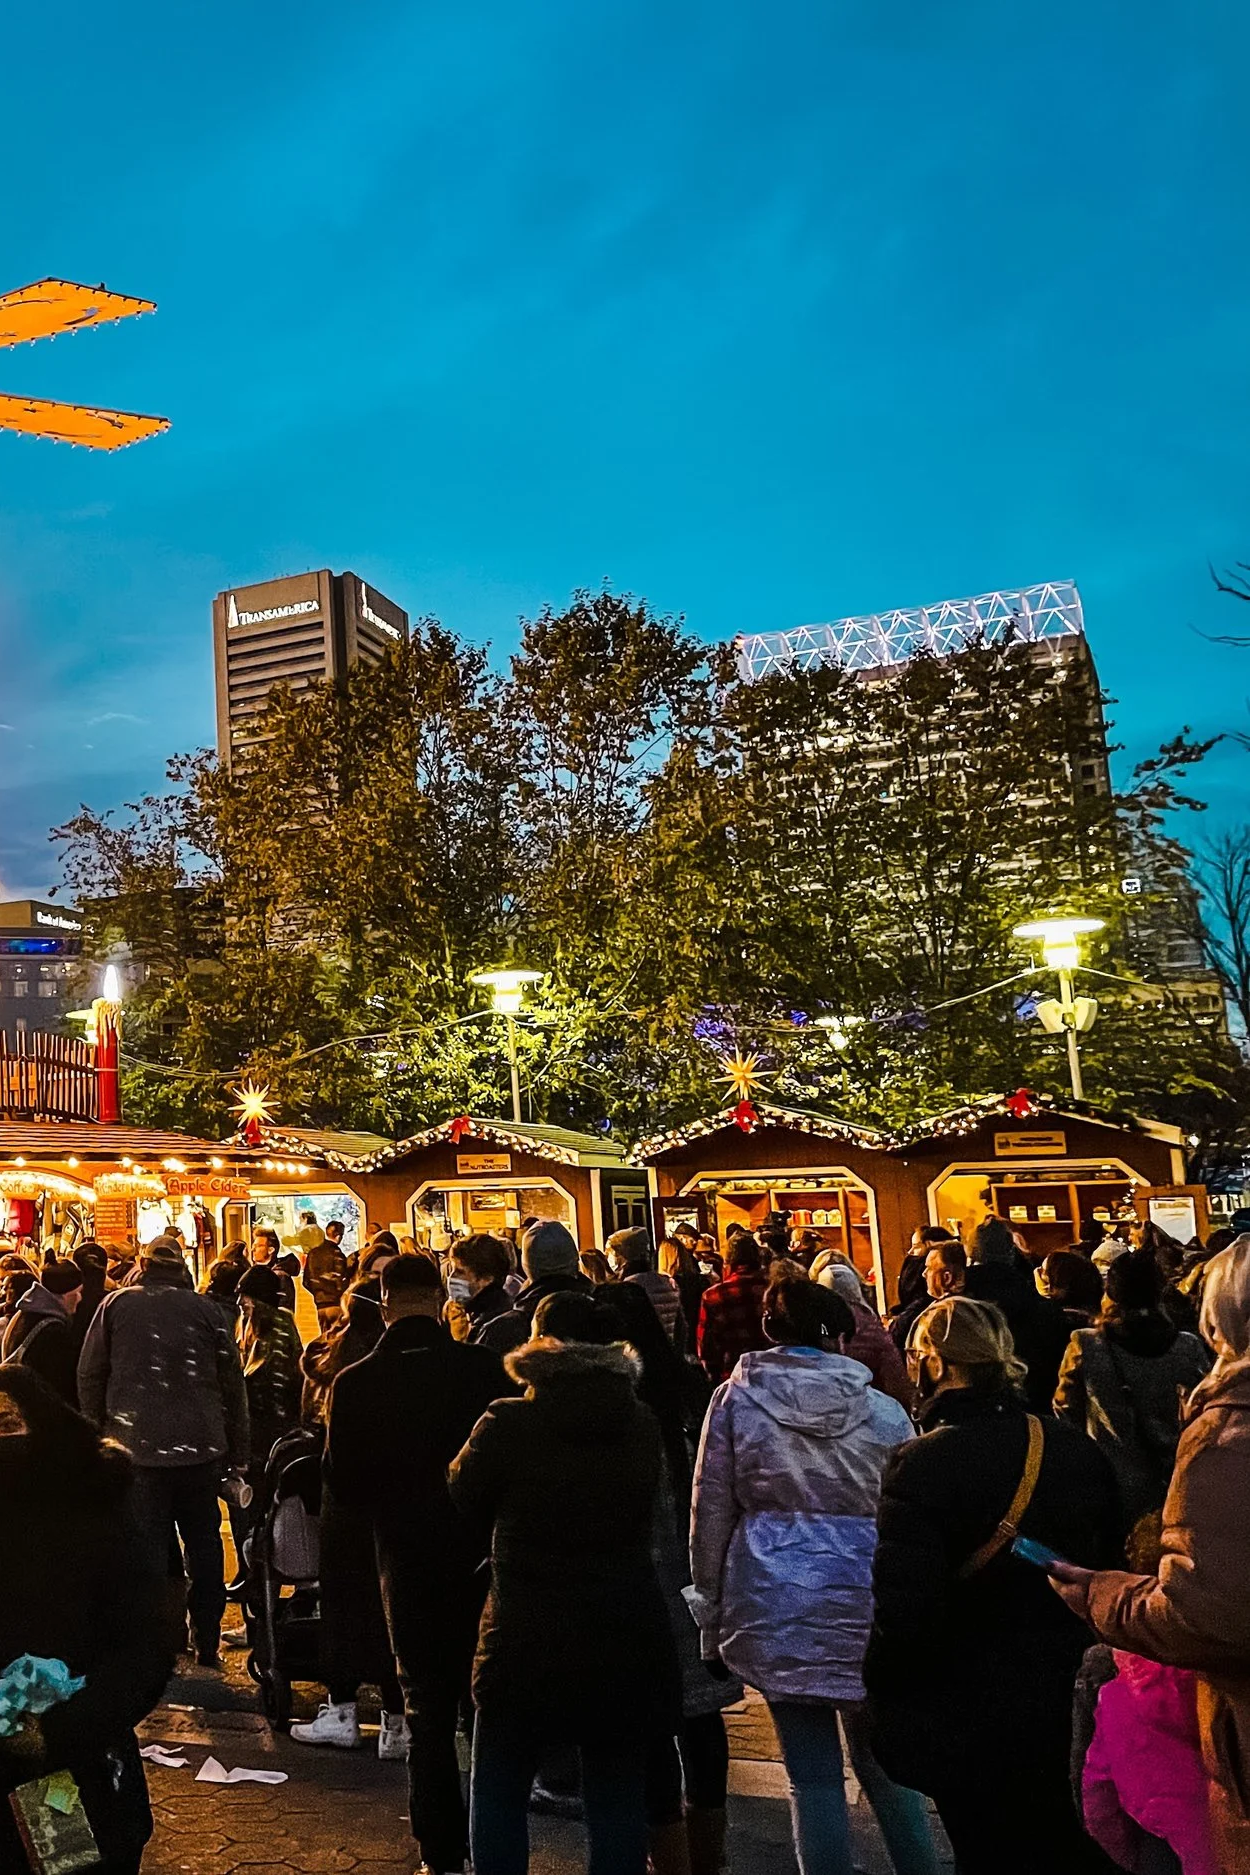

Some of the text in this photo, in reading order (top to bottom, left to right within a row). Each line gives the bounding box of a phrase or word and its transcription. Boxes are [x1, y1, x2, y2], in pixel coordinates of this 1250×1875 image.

[238, 600, 320, 625] TRANSAMERICA
[169, 1178, 244, 1193] Apple Cider
